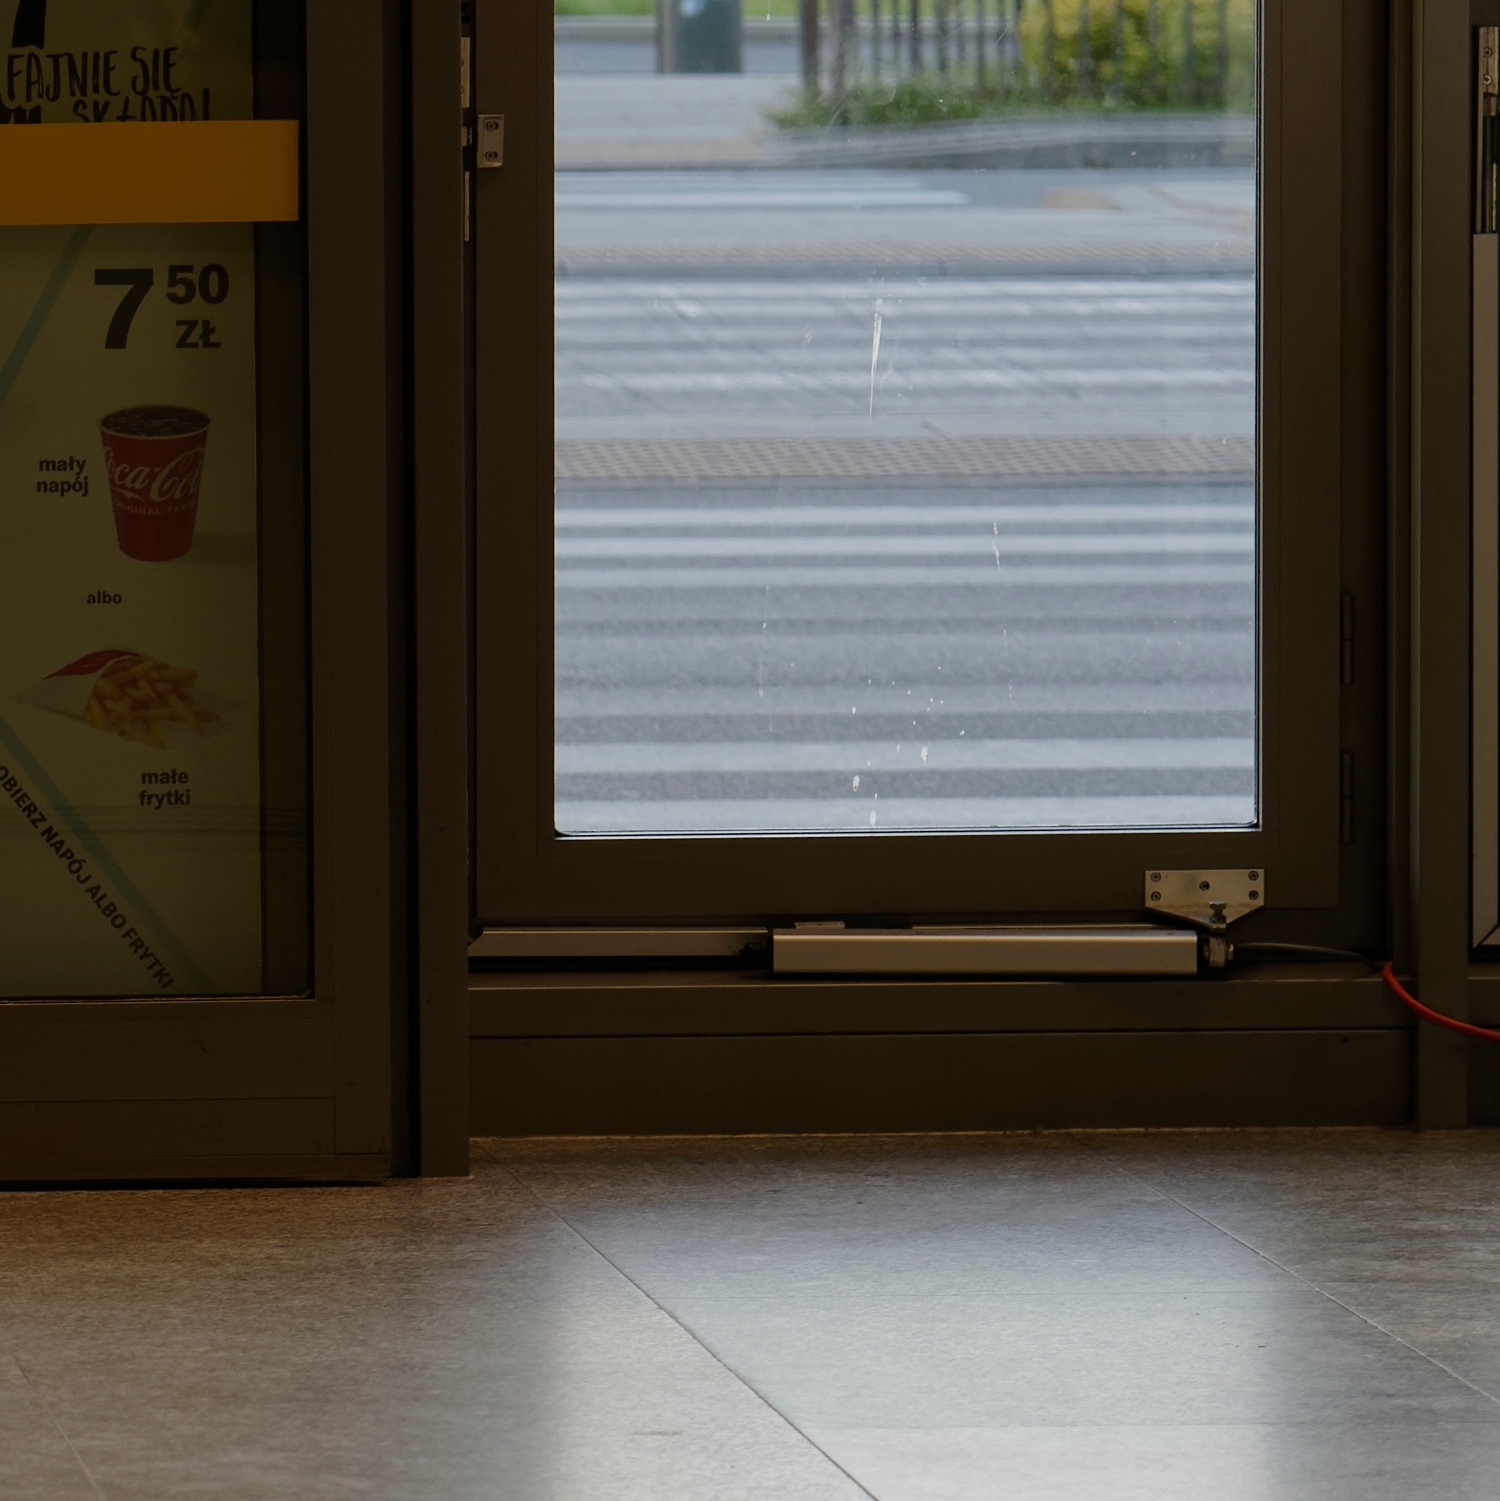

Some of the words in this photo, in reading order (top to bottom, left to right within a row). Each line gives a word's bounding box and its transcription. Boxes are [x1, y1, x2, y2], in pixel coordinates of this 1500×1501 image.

[7, 50, 120, 102] FAJNIE
[130, 46, 181, 100] SIĘ
[94, 268, 154, 349] 7
[166, 264, 229, 304] 50
[175, 320, 220, 349] ZŁ
[39, 455, 86, 474] mały
[36, 475, 90, 497] napój
[86, 589, 122, 603] albo
[141, 769, 189, 785] małe
[139, 789, 191, 809] frytki
[40, 825, 92, 884] NAPÓJ
[85, 885, 127, 929] ALBO
[122, 927, 174, 989] FRYTKI
